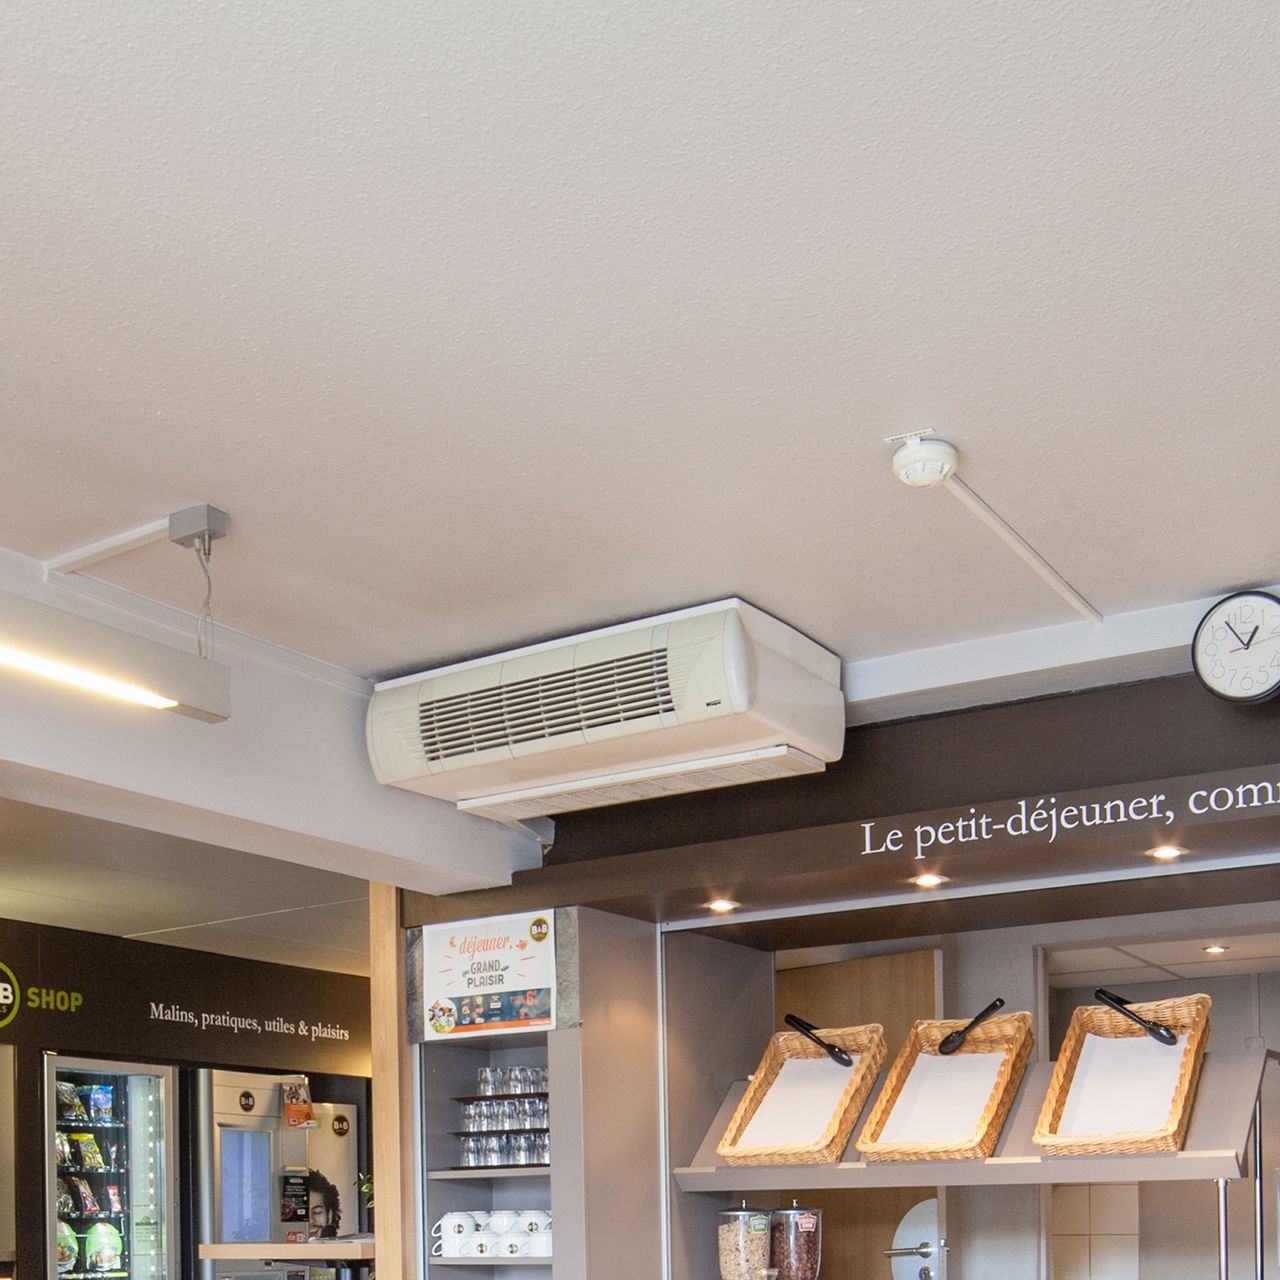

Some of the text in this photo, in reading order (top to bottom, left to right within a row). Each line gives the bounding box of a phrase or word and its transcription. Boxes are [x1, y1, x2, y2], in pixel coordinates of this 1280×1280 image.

[1239, 604, 1254, 625] 12
[1211, 624, 1228, 642] 10
[1211, 658, 1226, 679] 8
[1269, 653, 1280, 670] 4
[1228, 668, 1238, 687] 7
[1240, 671, 1254, 691] 6
[1256, 664, 1270, 685] 5
[860, 822, 904, 855] Le
[914, 796, 1174, 860] petit-déjeuner,
[470, 959, 501, 975] GRAND
[467, 974, 505, 989] PLAISIR
[26, 987, 84, 1012] SHOP
[150, 1002, 350, 1042] Malins, pratiques, utiles & plaisirs
